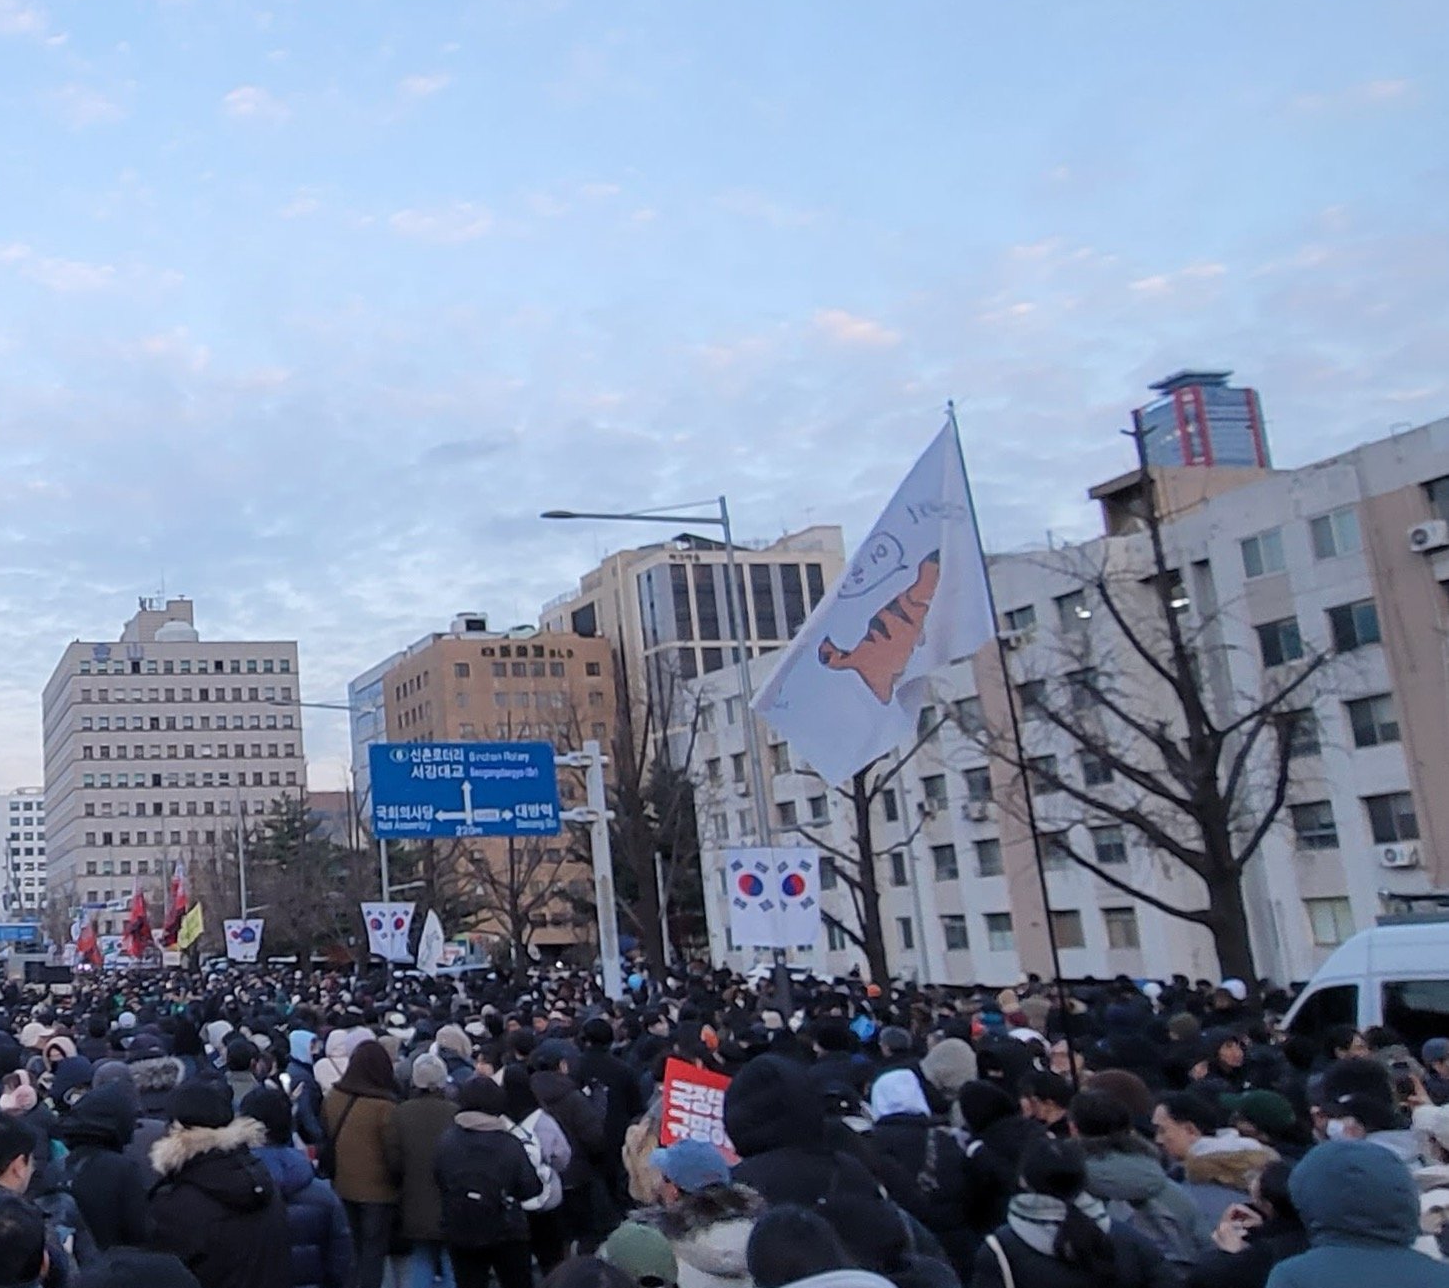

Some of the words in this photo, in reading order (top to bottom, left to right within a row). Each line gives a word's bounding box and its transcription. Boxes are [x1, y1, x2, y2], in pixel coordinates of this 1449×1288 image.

[410, 748, 464, 763] 신촌로터리
[375, 804, 434, 820] 국회의사당
[515, 803, 553, 818] 대방역
